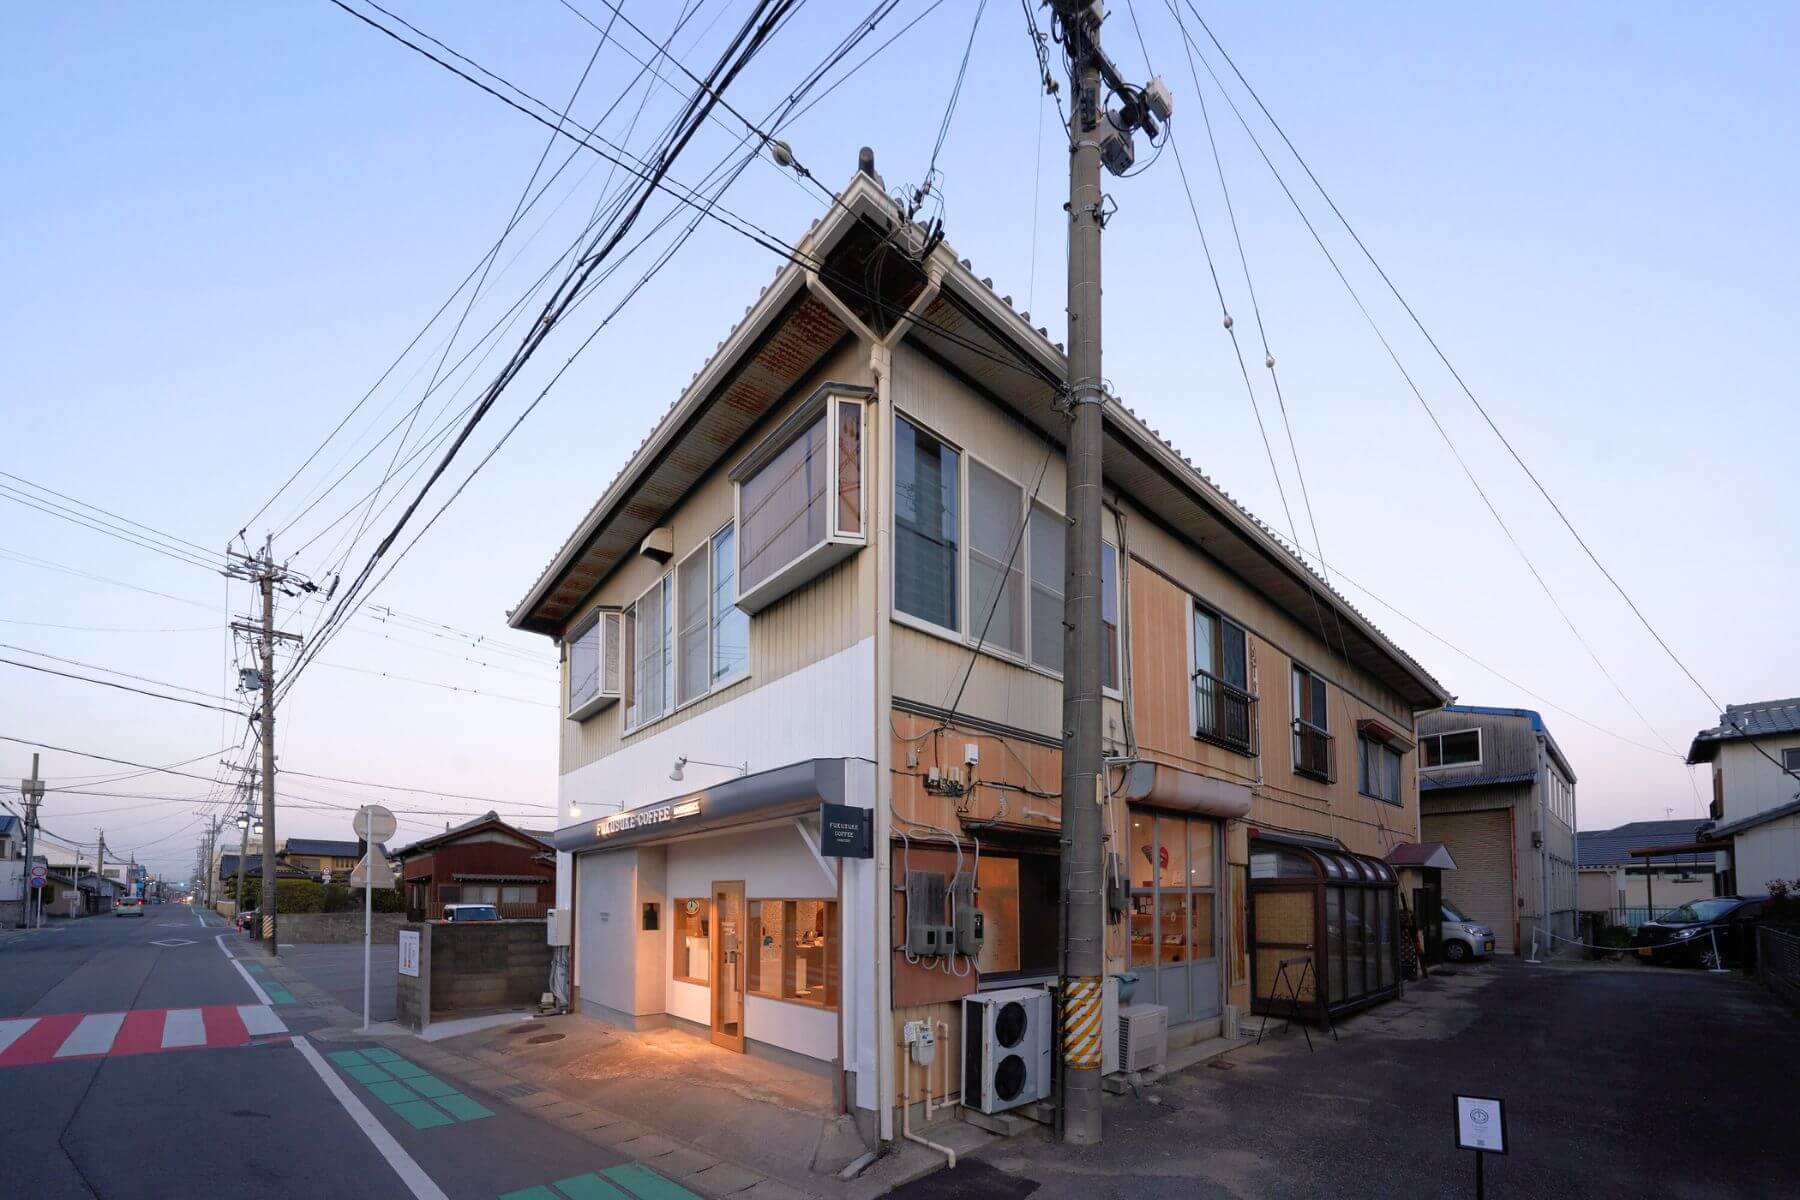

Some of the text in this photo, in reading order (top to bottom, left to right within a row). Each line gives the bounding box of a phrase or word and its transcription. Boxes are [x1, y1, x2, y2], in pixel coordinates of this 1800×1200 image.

[596, 815, 636, 836] FUKUSUKE
[638, 806, 671, 826] COFFEE
[834, 830, 854, 838] COFFEE
